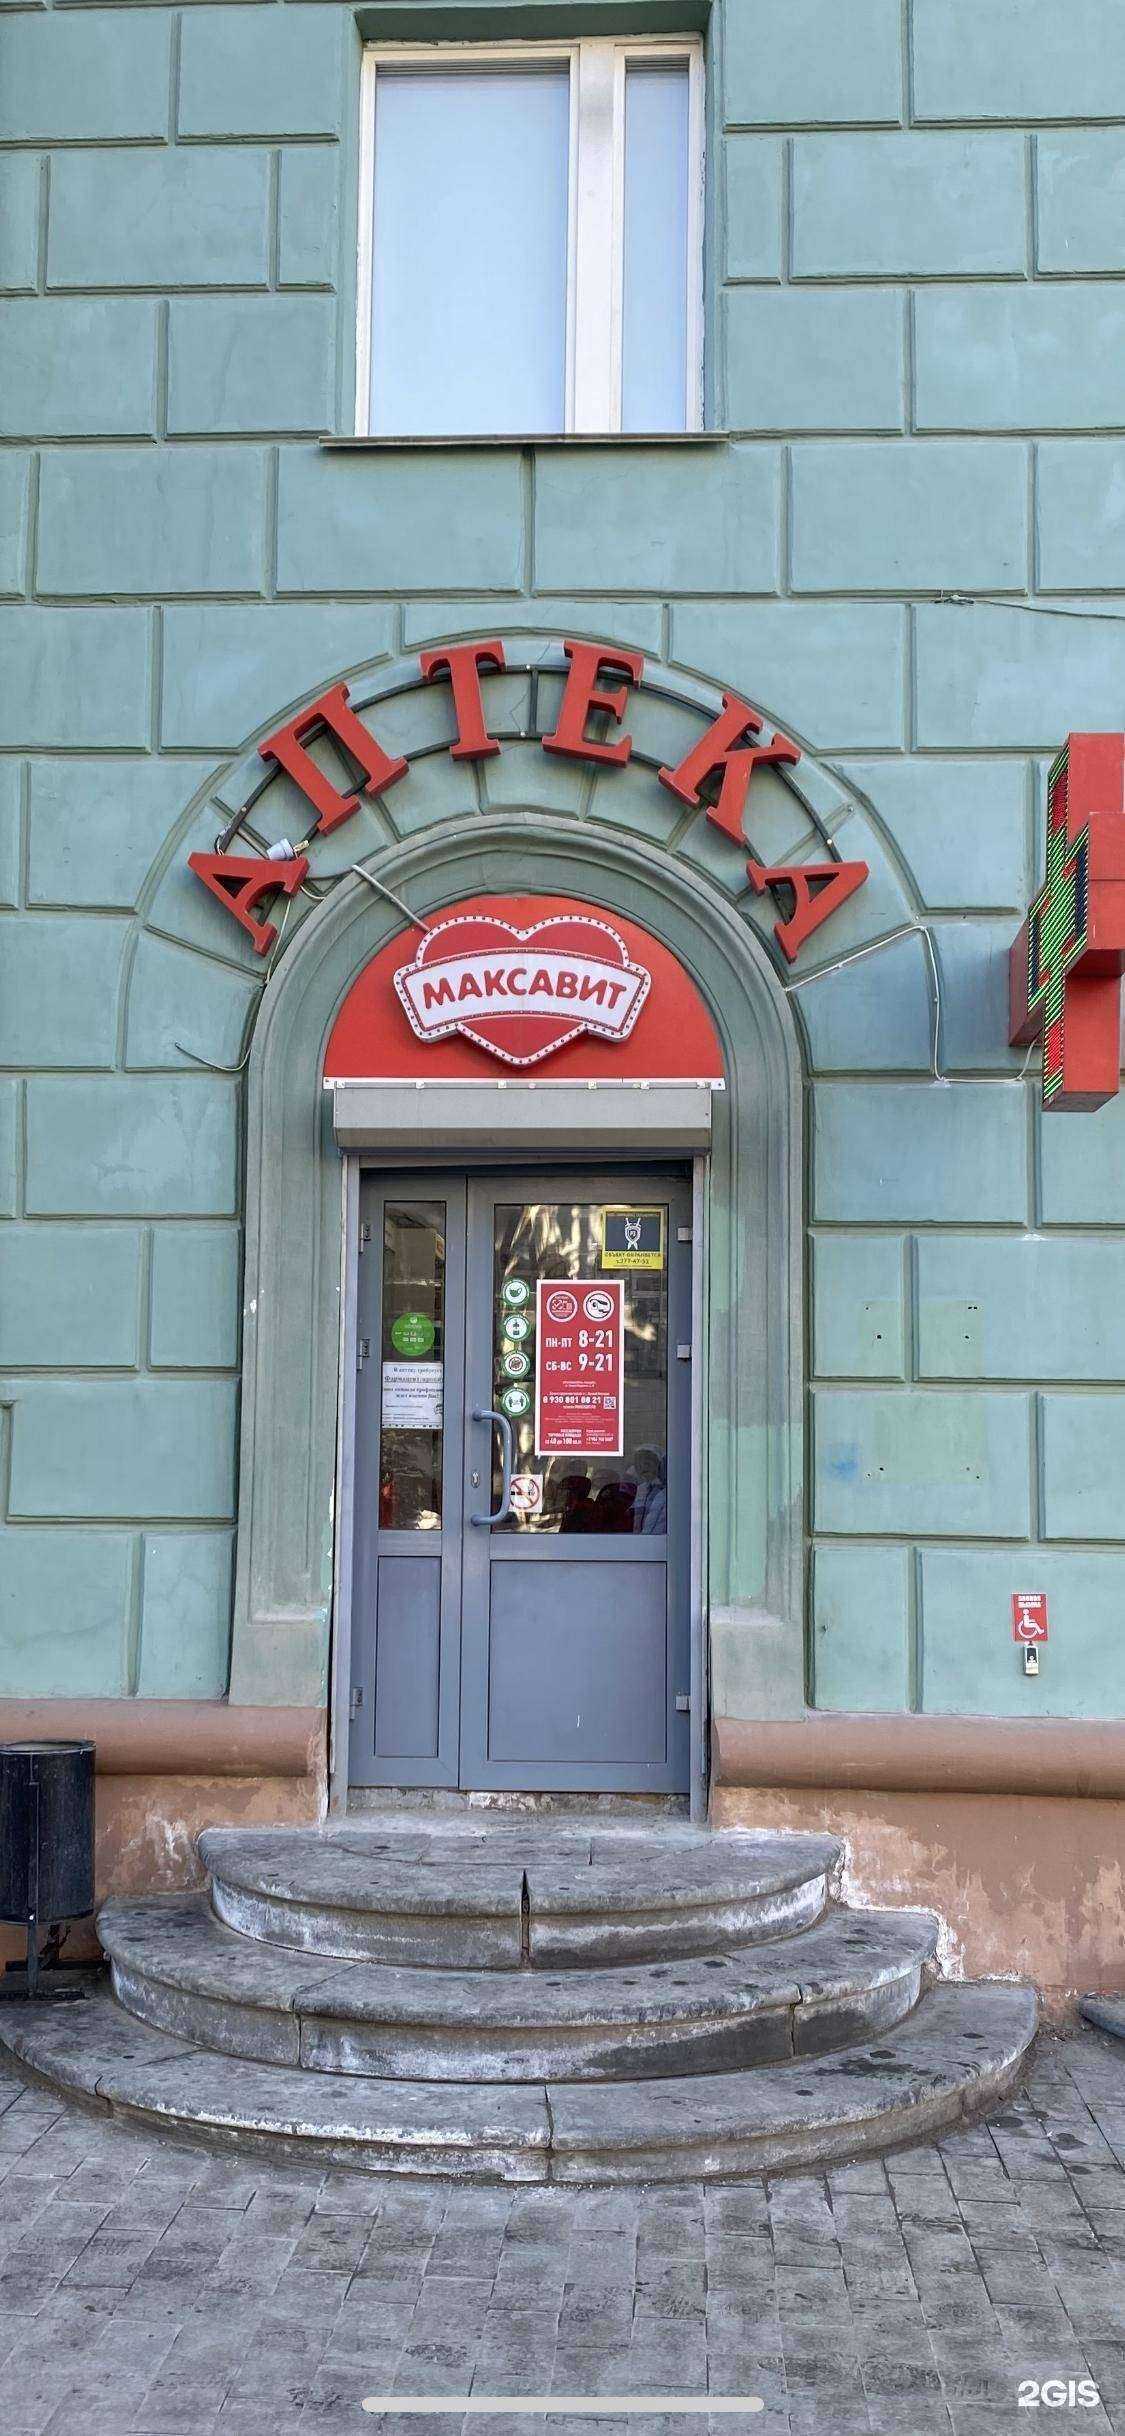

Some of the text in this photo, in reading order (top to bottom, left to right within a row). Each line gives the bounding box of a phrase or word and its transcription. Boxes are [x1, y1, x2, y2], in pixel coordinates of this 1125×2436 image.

[188, 639, 868, 962] АПТЕКА
[422, 966, 627, 1010] МАКСАВИТ
[545, 1329, 613, 1348] ПН-ПТ 8-21
[545, 1353, 613, 1372] СБ-ВС 9-21
